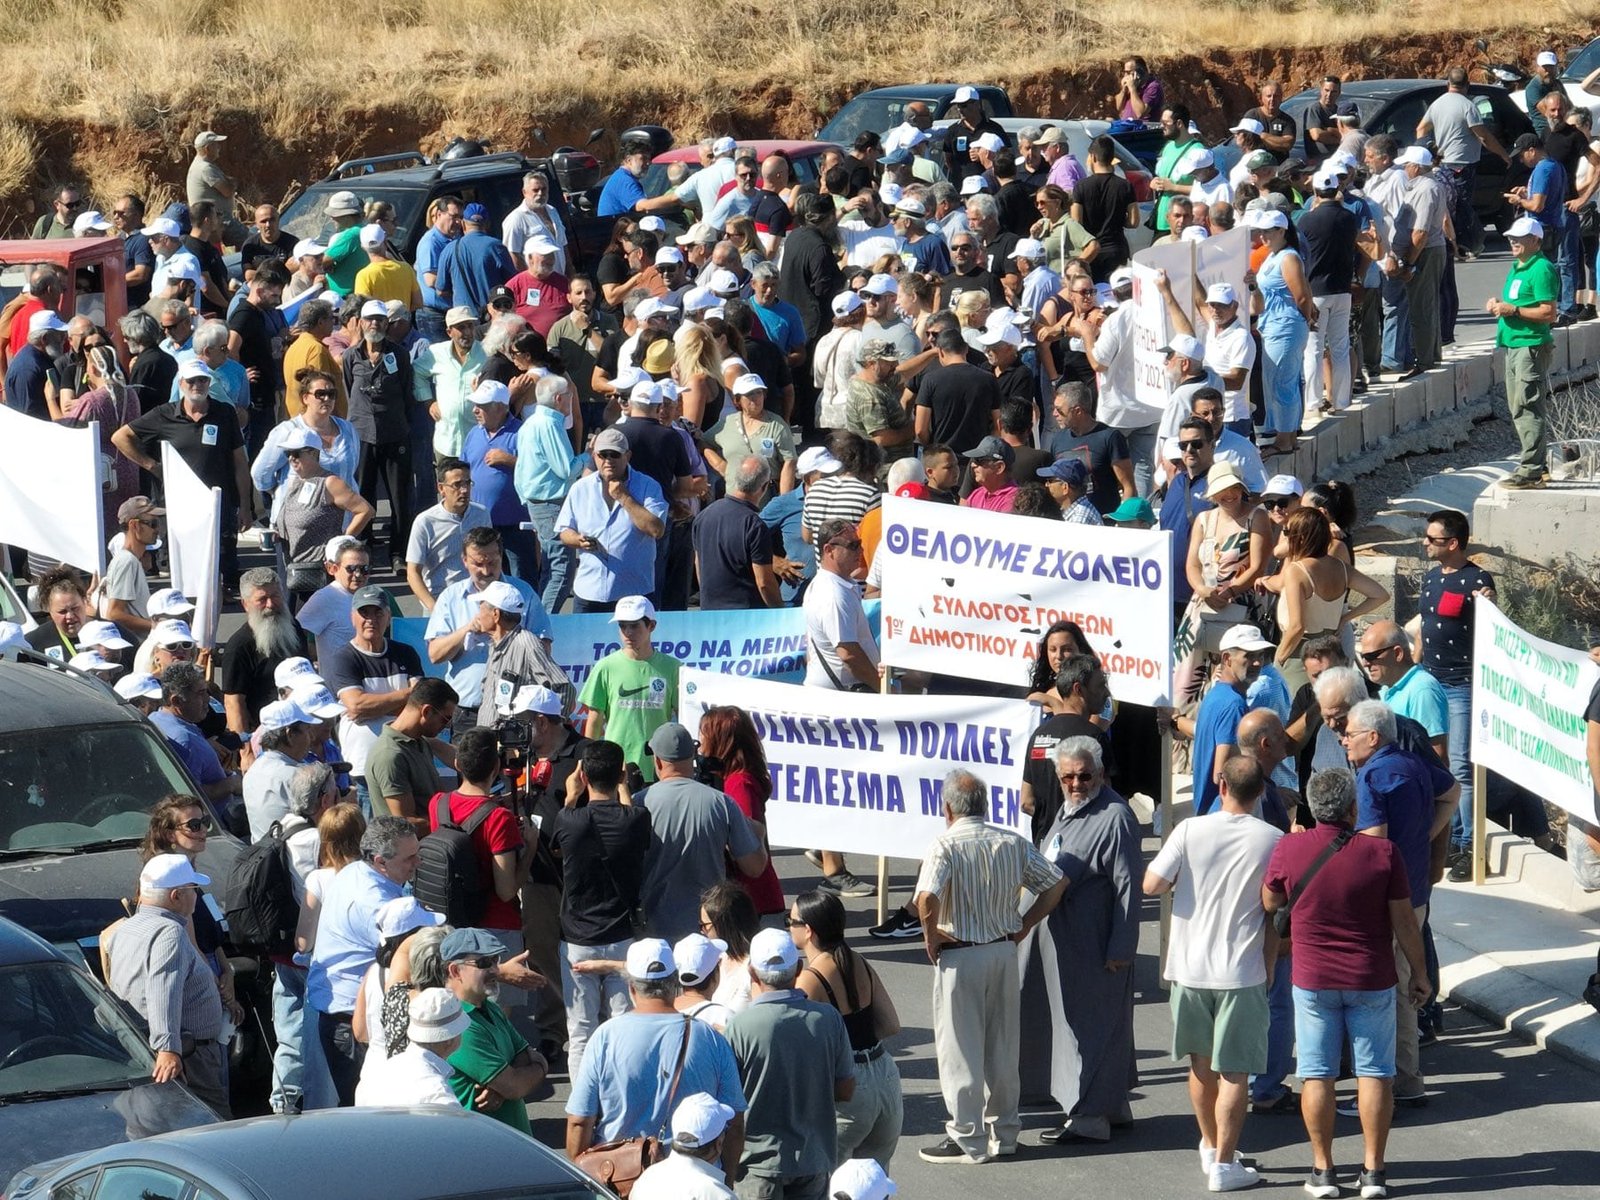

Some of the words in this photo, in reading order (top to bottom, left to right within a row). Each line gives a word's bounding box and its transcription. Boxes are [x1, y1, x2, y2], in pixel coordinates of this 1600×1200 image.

[886, 524, 1032, 573] ΘΕΛΟΥΜΕ
[1032, 547, 1161, 590] ΣΧΟΛΕΙΟ
[933, 595, 1031, 624] ΣΥΛΛΟΓΟΣ
[1036, 608, 1113, 636] ΓΟΝΕΩΝ
[700, 640, 732, 658] ΝΑ
[741, 634, 808, 656] ΜΕΙΝΕ
[909, 626, 1017, 657] ΔΗΜΟΤΙΚΟΥ
[720, 655, 807, 676] ΚΟΙΝΩΝ
[894, 720, 1014, 766] ΠΟΛΛΕΣ
[766, 762, 906, 813] ΤΕΛΕΣΜΑ
[919, 777, 1020, 828] ΜΕΝ
